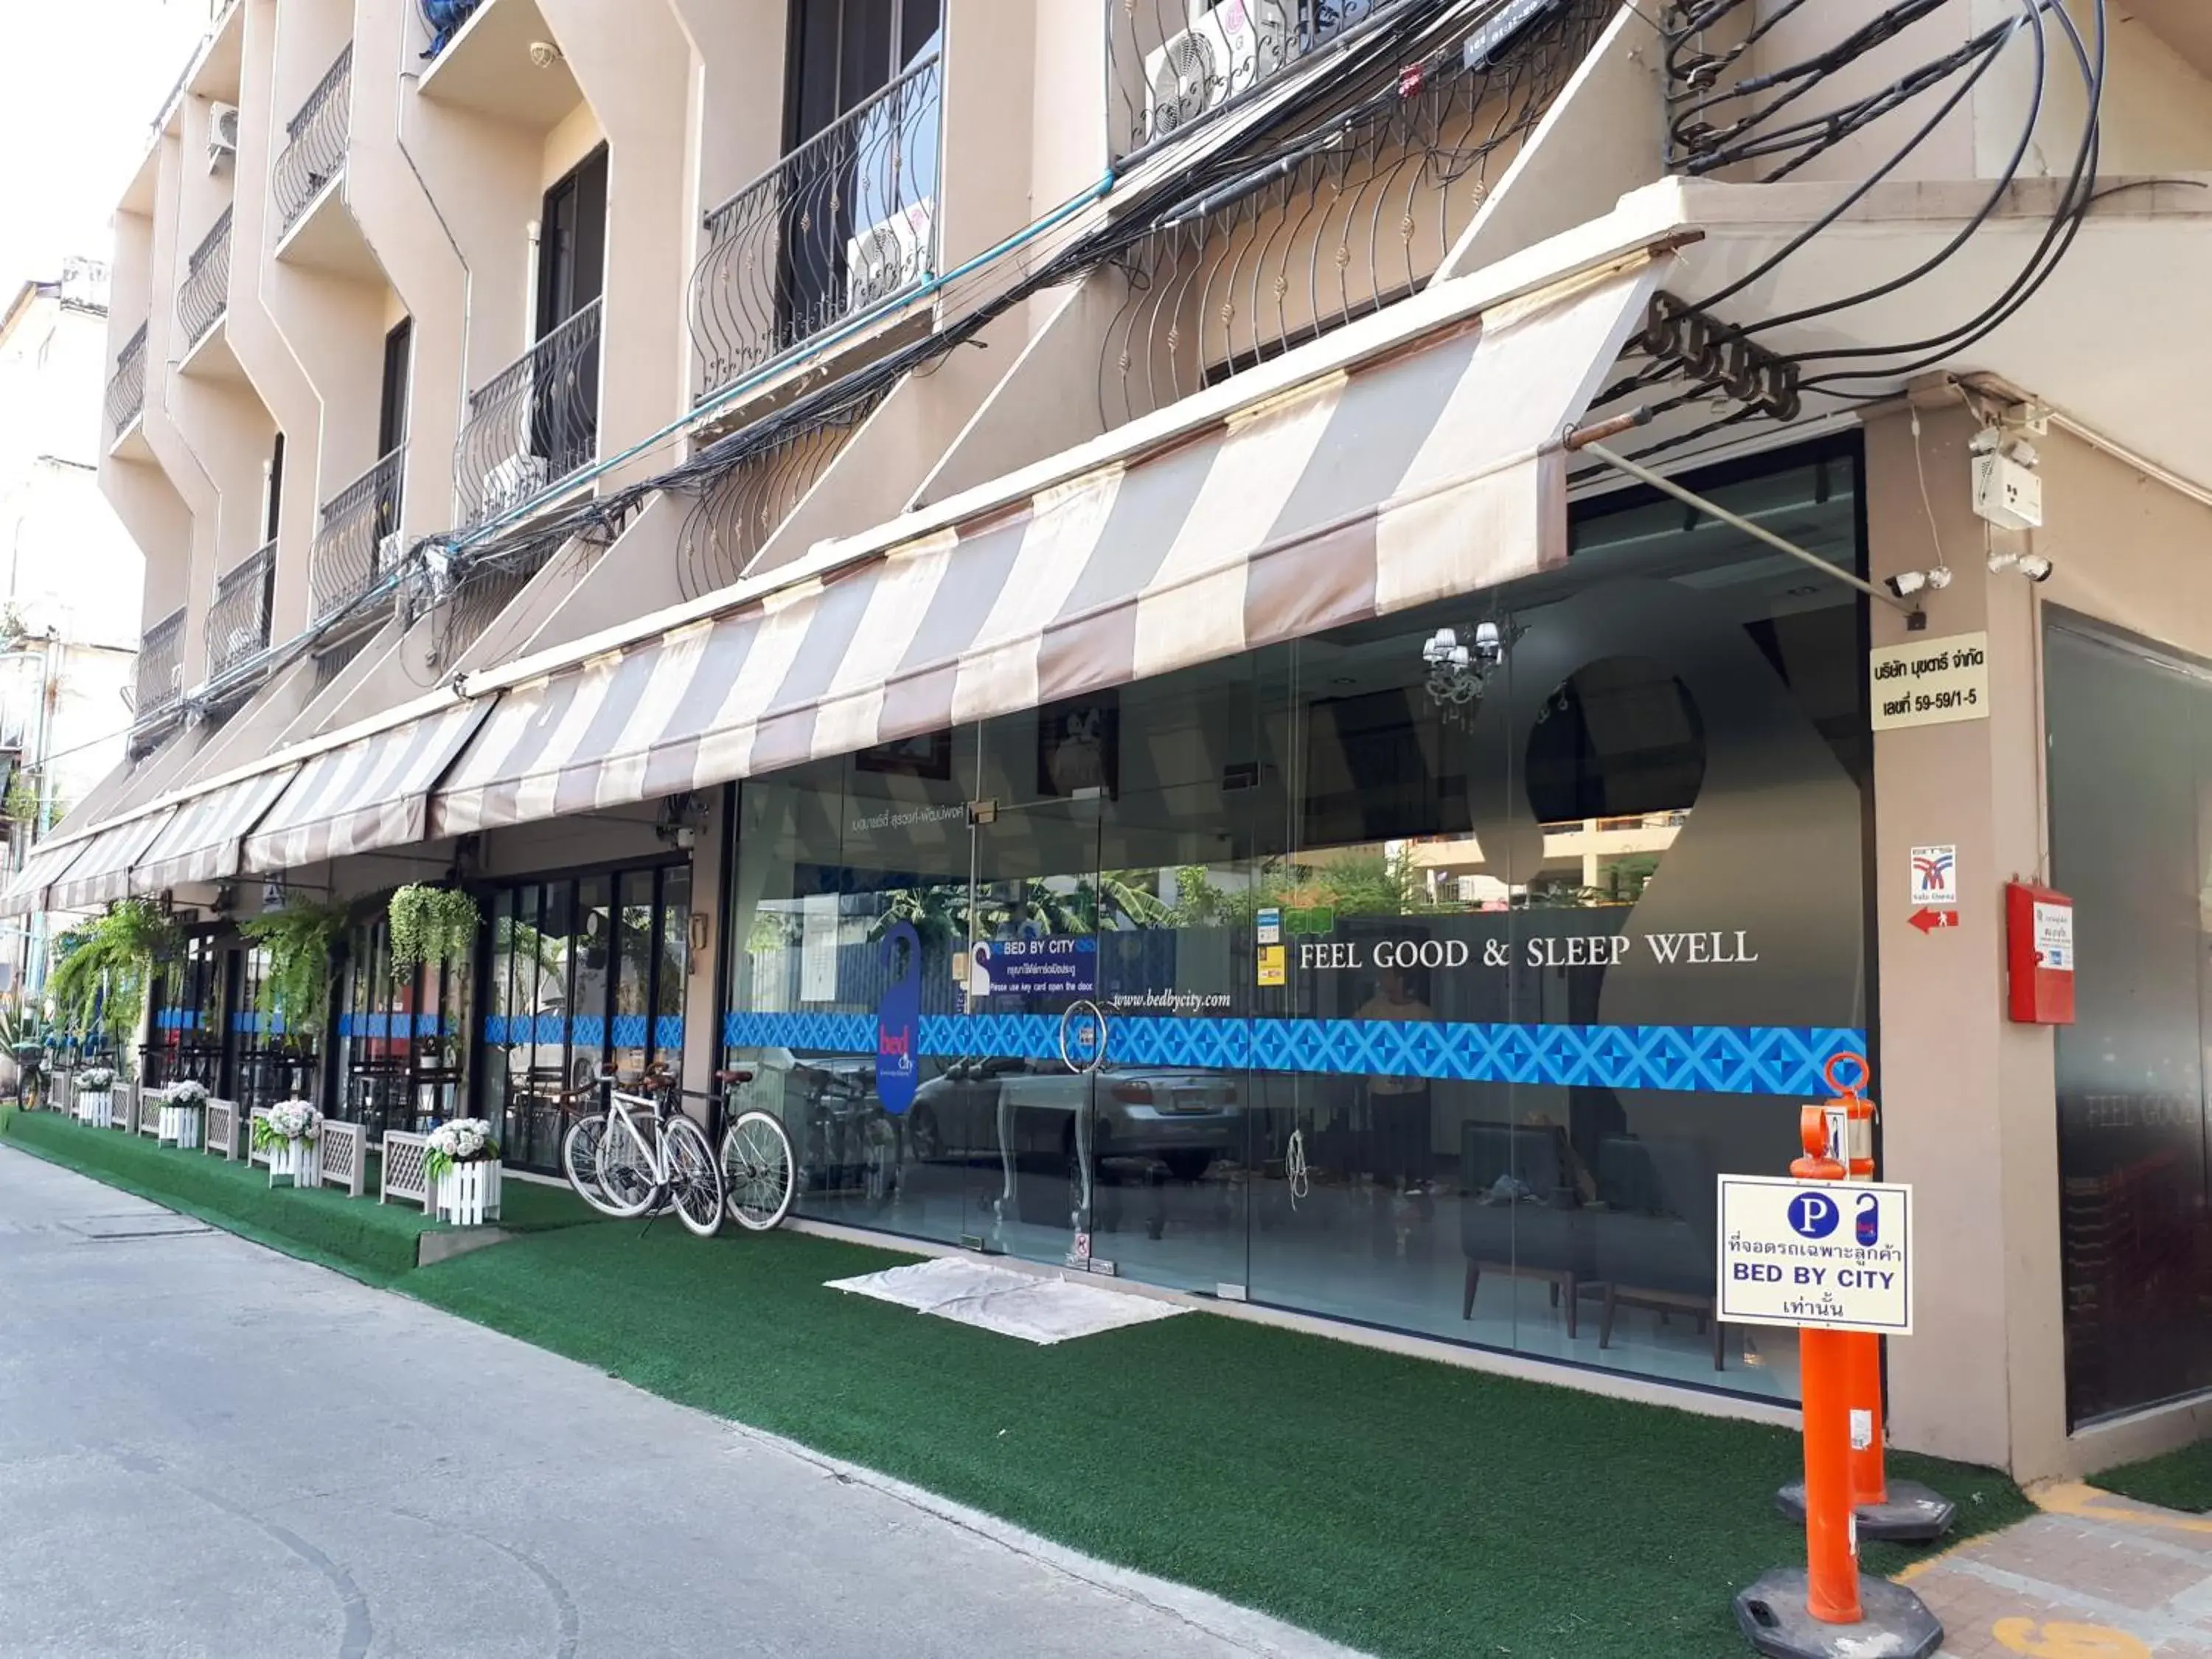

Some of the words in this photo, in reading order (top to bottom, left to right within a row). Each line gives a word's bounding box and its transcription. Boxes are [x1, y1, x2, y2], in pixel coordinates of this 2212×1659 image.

[1875, 659, 1907, 681] บริษัท
[1952, 648, 1984, 668] จำกัด
[1883, 691, 1910, 716] เลขที่
[1004, 942, 1026, 955] BED
[1030, 941, 1045, 954] BY
[1048, 940, 1075, 953] CITY
[1299, 942, 1363, 970] FEEL
[1373, 940, 1469, 969] GOOD
[1483, 937, 1510, 967] &
[1526, 935, 1630, 967] SLEEP
[1644, 931, 1759, 964] WELL
[1034, 981, 1046, 991] card
[1048, 984, 1064, 993] open
[1065, 981, 1076, 991] the
[1114, 988, 1231, 1012] www.bedbycity.com
[1800, 1197, 1828, 1231] P
[1728, 1231, 1902, 1266] ที่จอดรถเฉพาะลูกค้า
[1733, 1263, 1783, 1282] BED
[1794, 1266, 1826, 1285] BY
[1837, 1269, 1895, 1290] CITY
[1784, 1292, 1843, 1316] เท่านั้น
